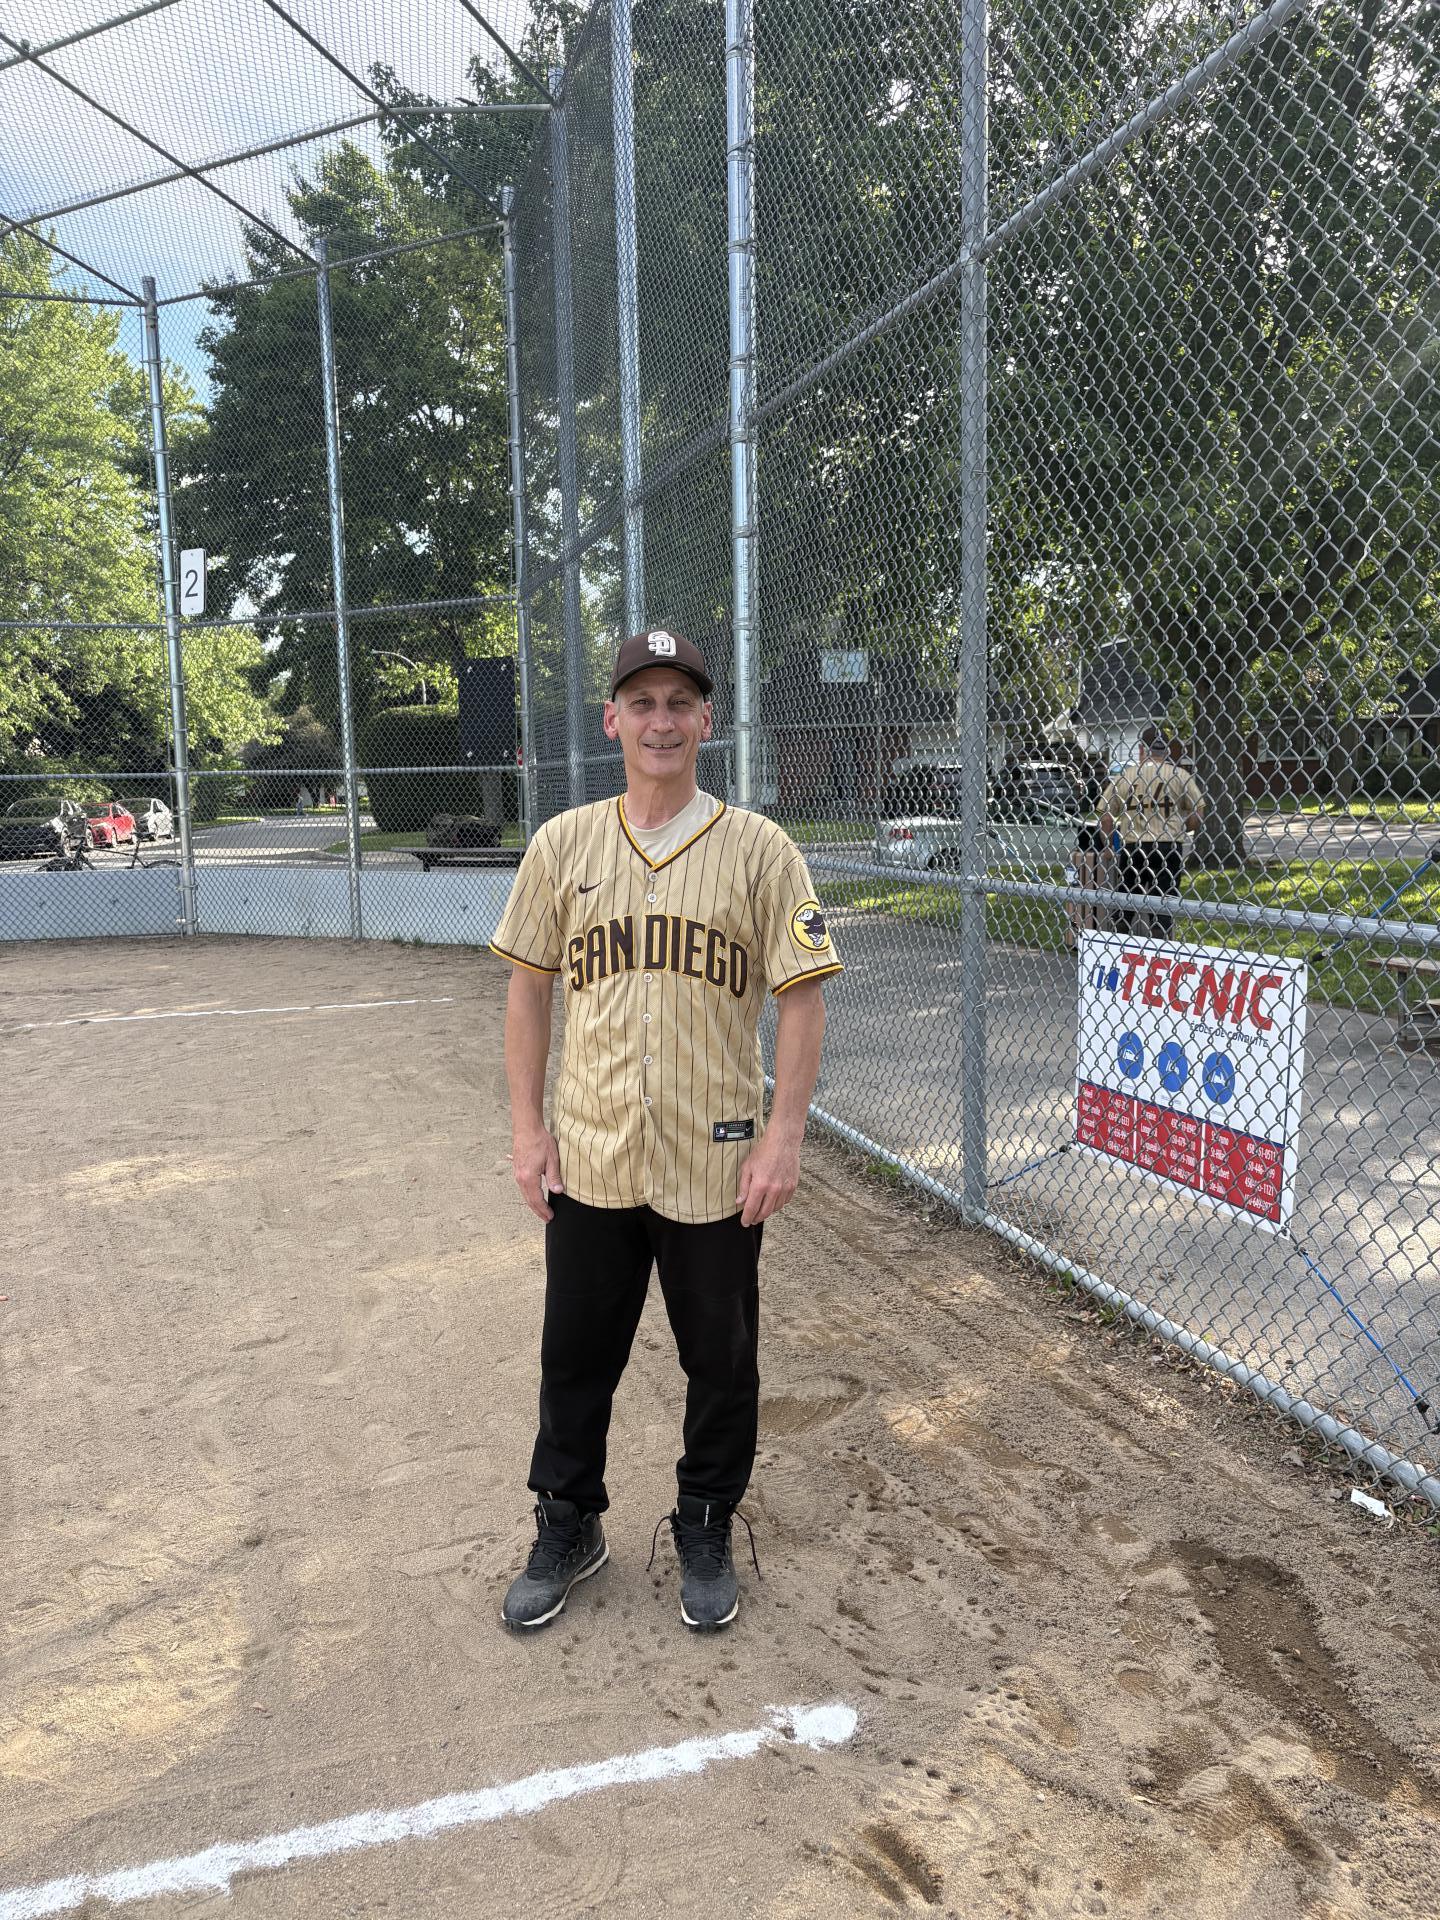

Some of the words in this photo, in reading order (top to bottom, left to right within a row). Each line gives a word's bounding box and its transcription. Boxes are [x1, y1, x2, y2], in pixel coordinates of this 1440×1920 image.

[185, 569, 199, 598] 2
[647, 631, 677, 657] SD
[567, 914, 637, 992] SAN
[642, 913, 749, 999] DIEGO
[1121, 952, 1284, 1032] TECNIC
[1215, 1027, 1225, 1038] DE
